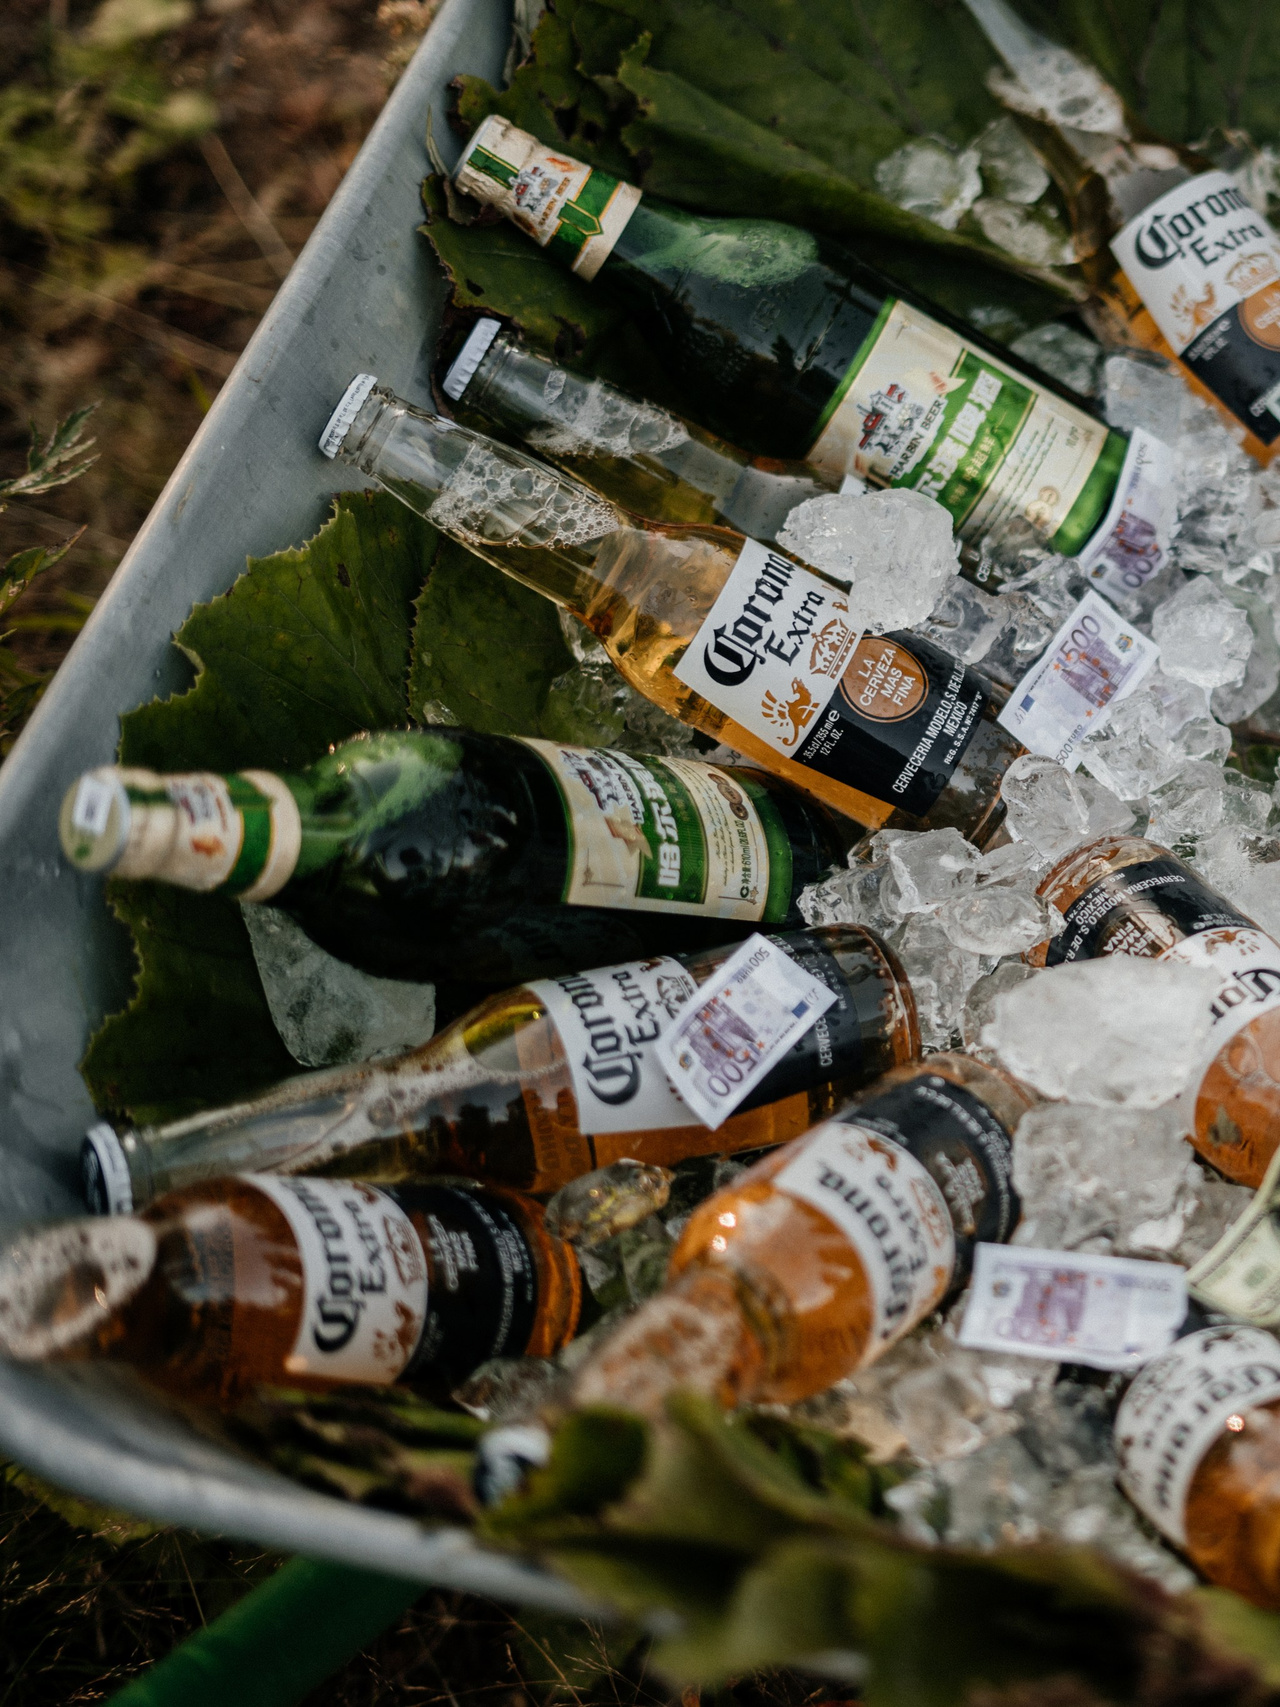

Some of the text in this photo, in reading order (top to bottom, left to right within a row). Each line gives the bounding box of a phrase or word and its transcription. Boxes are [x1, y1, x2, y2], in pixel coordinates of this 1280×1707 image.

[1189, 225, 1265, 267] Extra
[890, 399, 944, 477] HARBIN BEER
[703, 553, 797, 686] Corona
[763, 591, 826, 667] Extra
[1060, 614, 1102, 664] 500
[858, 657, 876, 678] LA
[859, 648, 896, 706] CERVEZA
[880, 667, 903, 698] MAS
[892, 675, 916, 706] FINA
[943, 701, 968, 737] MEXICO
[944, 749, 958, 765] REG.
[953, 725, 971, 747] S.S.A.
[969, 702, 980, 718] 7417
[892, 738, 934, 793] CERVECERIA
[924, 700, 956, 739] MODELO,
[1056, 723, 1084, 766] 500 EURO
[616, 772, 643, 822] HARBIN
[1075, 889, 1109, 926] MEXICO
[1123, 875, 1186, 897] CERVECERIA
[1088, 891, 1127, 927] MODELO,
[750, 946, 771, 968] 500
[1071, 936, 1084, 951] DE
[1103, 922, 1135, 951] FINA
[612, 970, 661, 1047] Extra
[555, 975, 642, 1105] Coron
[707, 1052, 759, 1098] 500
[343, 1201, 388, 1294] Extra
